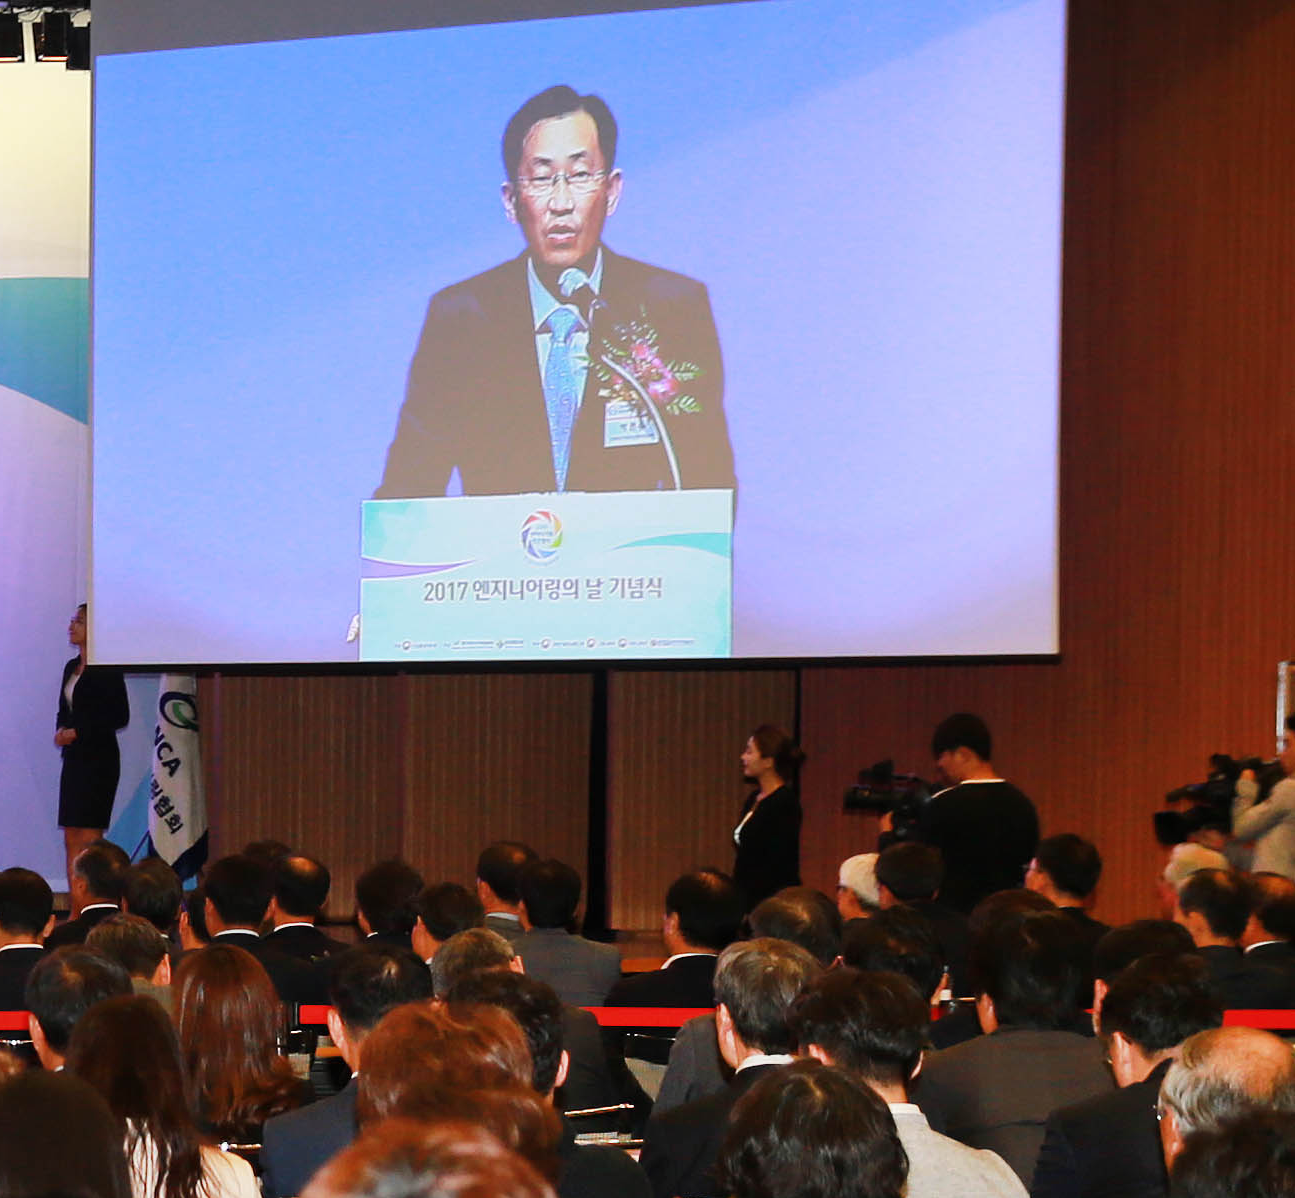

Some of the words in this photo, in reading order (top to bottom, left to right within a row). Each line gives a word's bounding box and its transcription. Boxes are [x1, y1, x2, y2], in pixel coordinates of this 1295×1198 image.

[423, 580, 468, 602] 2017
[472, 578, 580, 601] 엔지니어링의
[585, 578, 605, 601] 날
[609, 576, 663, 600] 기념식
